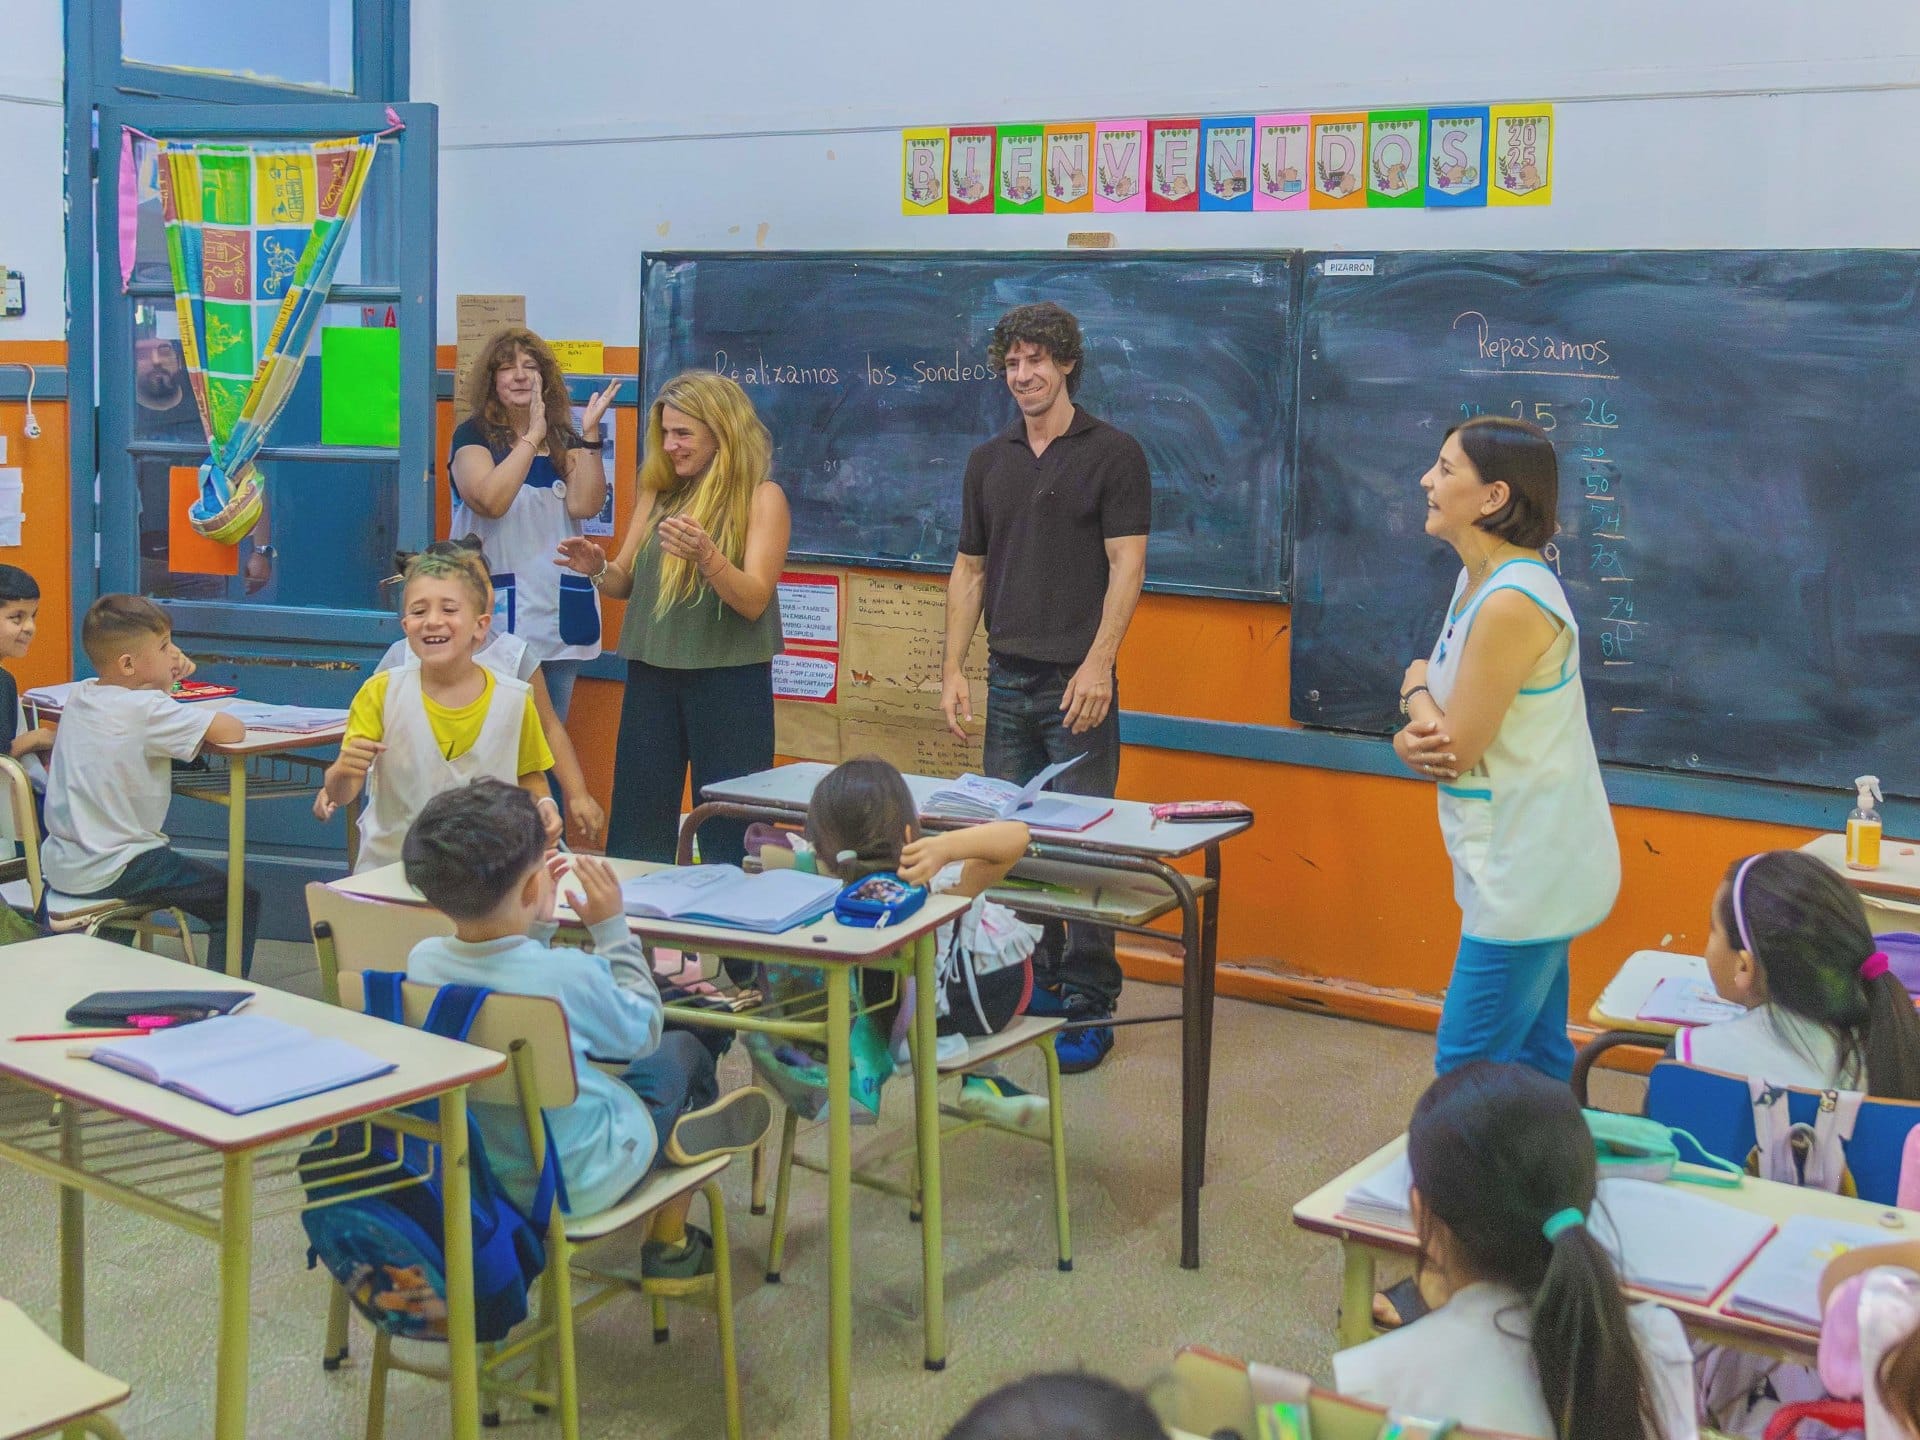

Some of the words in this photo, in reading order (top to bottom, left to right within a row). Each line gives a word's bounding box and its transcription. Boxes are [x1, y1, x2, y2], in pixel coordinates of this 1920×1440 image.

[1508, 123, 1536, 147] 20
[1507, 146, 1536, 170] 25
[1330, 262, 1372, 272] PIZARRÓN
[1453, 311, 1610, 368] Repasamos
[714, 349, 839, 386] Realizamos
[866, 352, 897, 386] los
[1581, 397, 1617, 425] 26
[1586, 474, 1609, 495] 50
